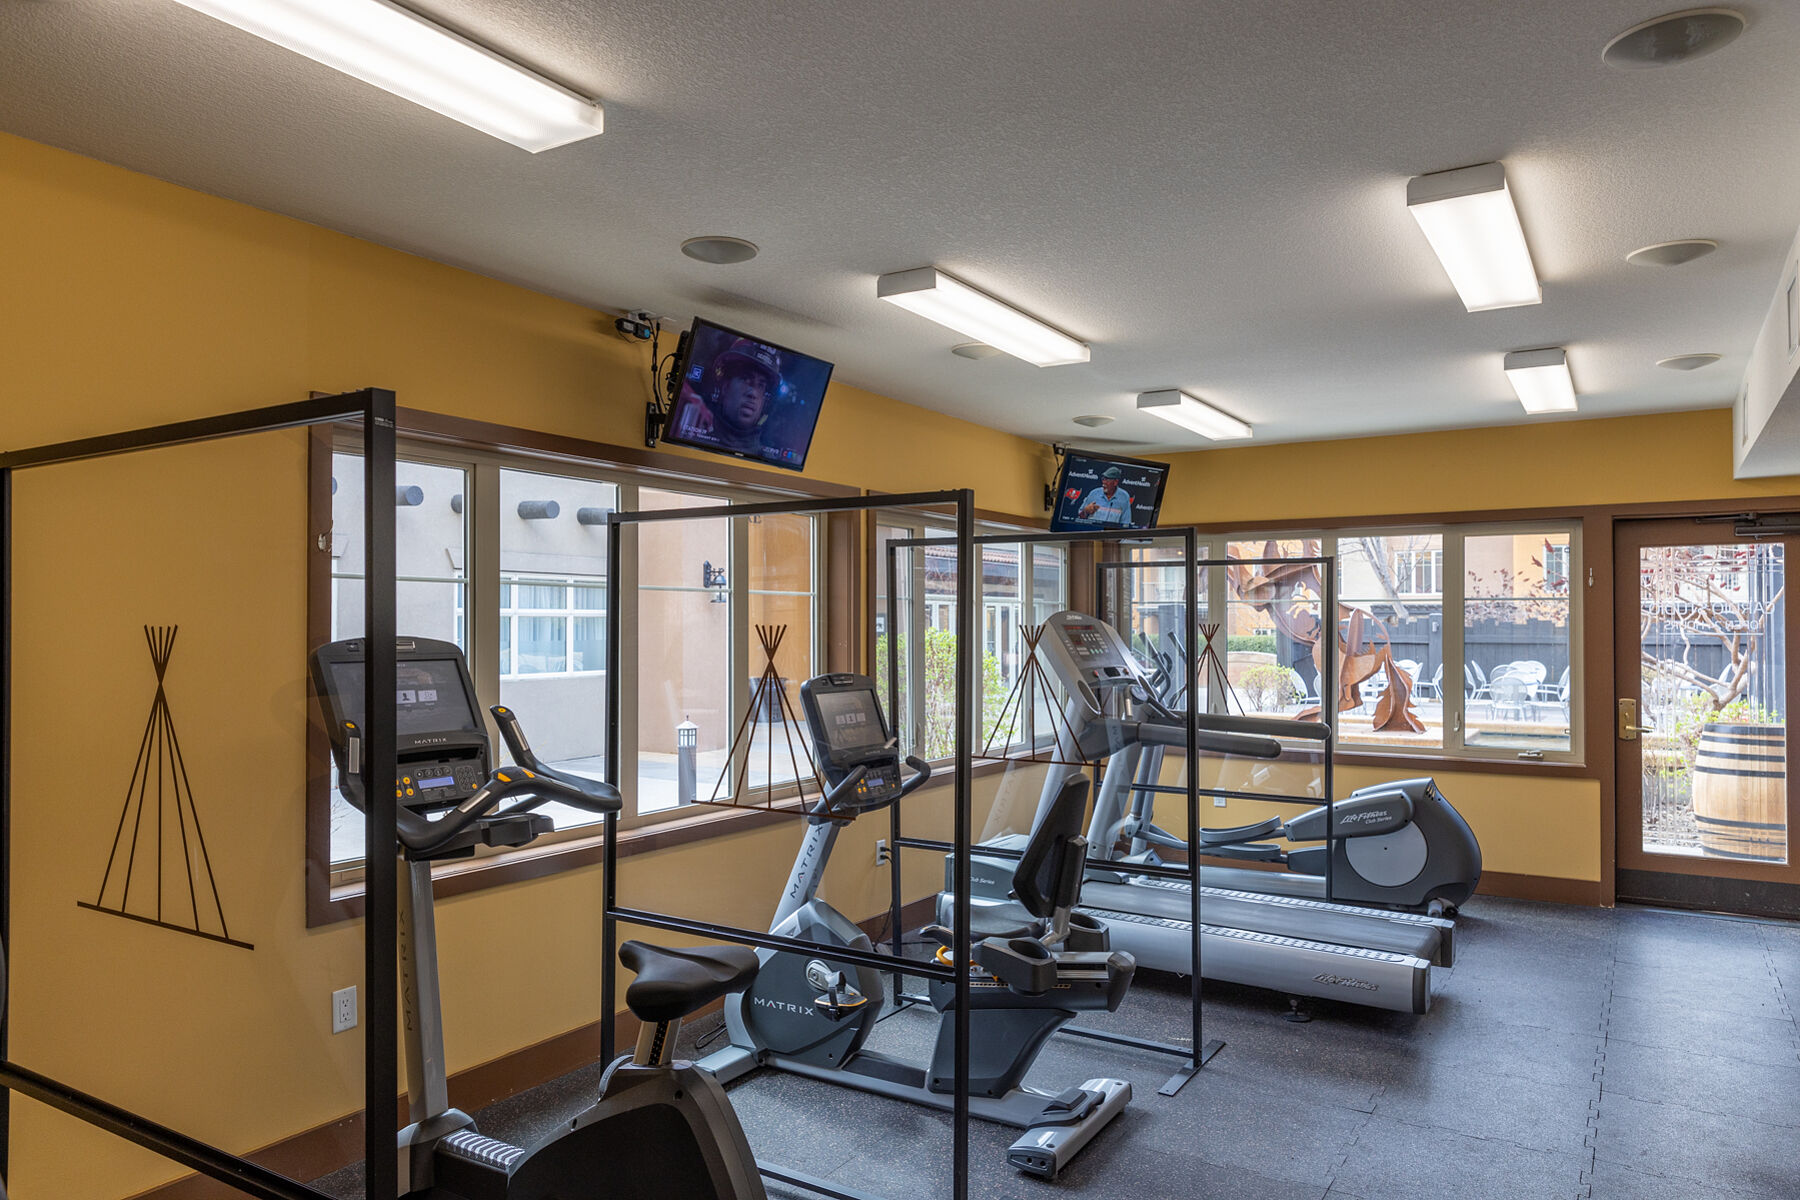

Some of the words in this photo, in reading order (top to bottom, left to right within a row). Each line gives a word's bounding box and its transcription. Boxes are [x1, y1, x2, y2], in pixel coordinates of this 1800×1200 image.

[1068, 471, 1099, 480] AdventHealth
[1122, 479, 1151, 488] AdventHealth
[414, 737, 448, 745] MATRIX
[789, 825, 823, 899] MATRIX
[399, 910, 413, 1031] MATRIX
[753, 996, 815, 1017] MATRIX
